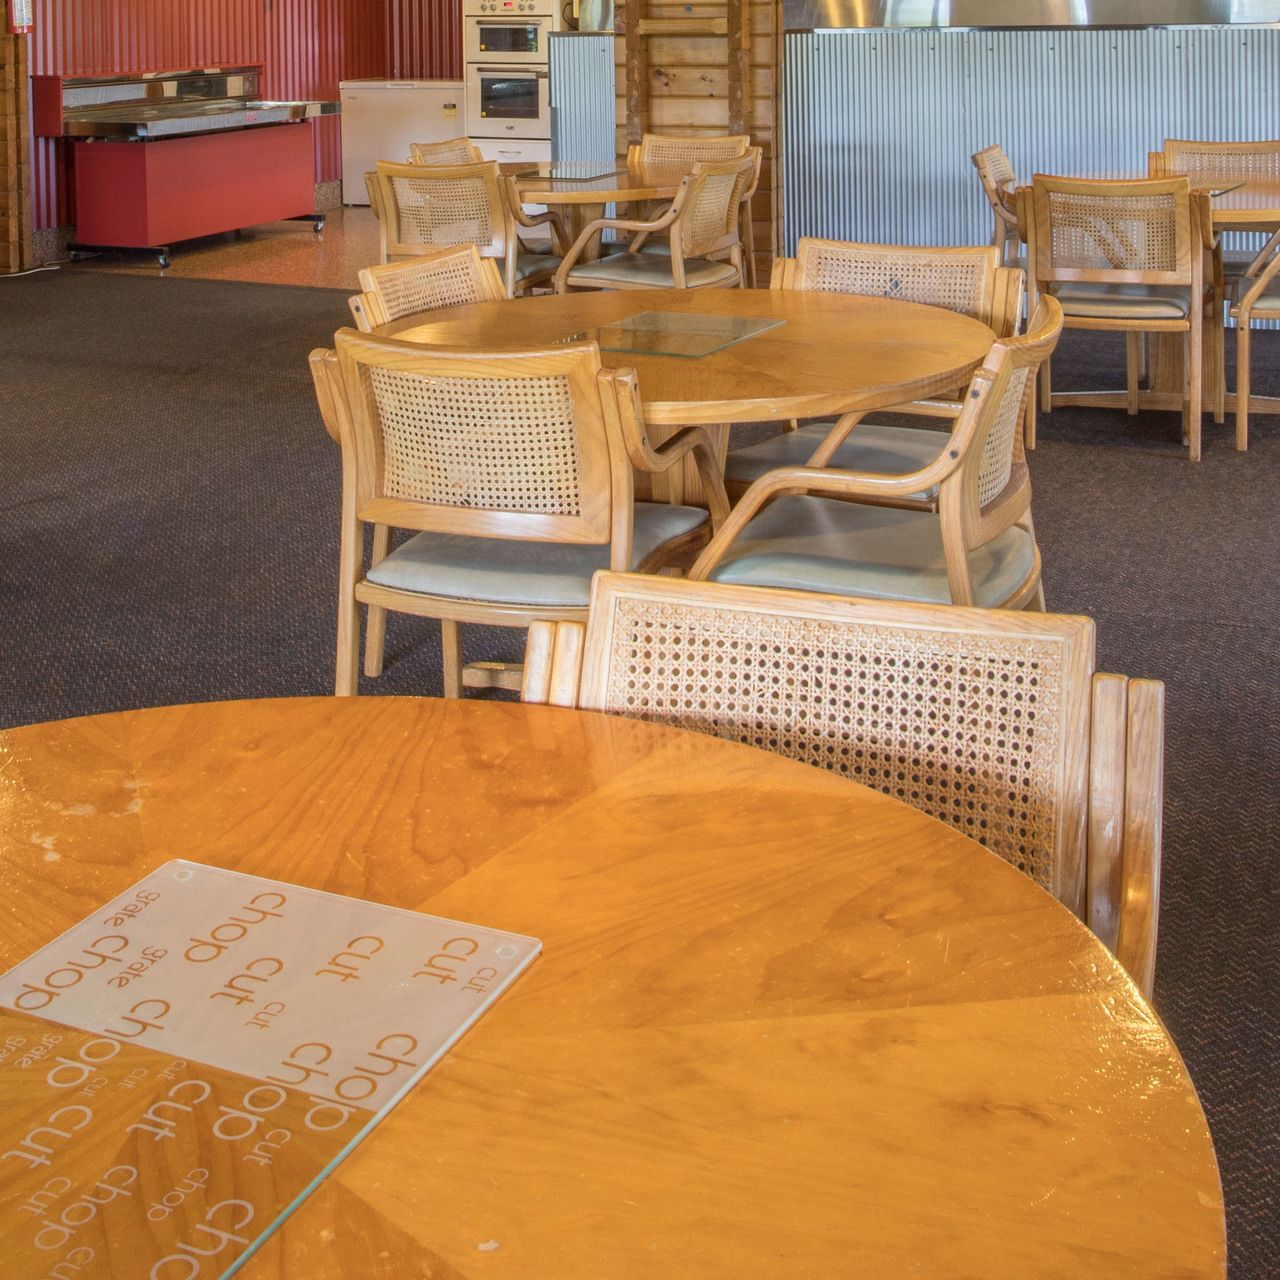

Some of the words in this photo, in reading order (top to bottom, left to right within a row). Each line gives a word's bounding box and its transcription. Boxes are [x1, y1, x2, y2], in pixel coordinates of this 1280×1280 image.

[104, 889, 161, 927] grate
[184, 892, 287, 963] chop
[14, 935, 129, 1011] chop
[107, 945, 168, 988] grate
[209, 957, 284, 1006] cut
[315, 935, 384, 982] cut
[412, 937, 479, 984] cut
[462, 967, 497, 994] cut
[245, 1001, 285, 1030] cut
[46, 999, 171, 1088] chop
[212, 1042, 332, 1140] chop
[304, 1033, 418, 1131] chop
[126, 1079, 211, 1141] cut
[0, 1105, 93, 1169] cut
[242, 1128, 291, 1166] cut
[17, 1176, 71, 1217] cut
[33, 1165, 138, 1250] chop
[147, 1168, 209, 1222] chop
[47, 1247, 95, 1280] cu
[149, 1199, 254, 1280] cho
